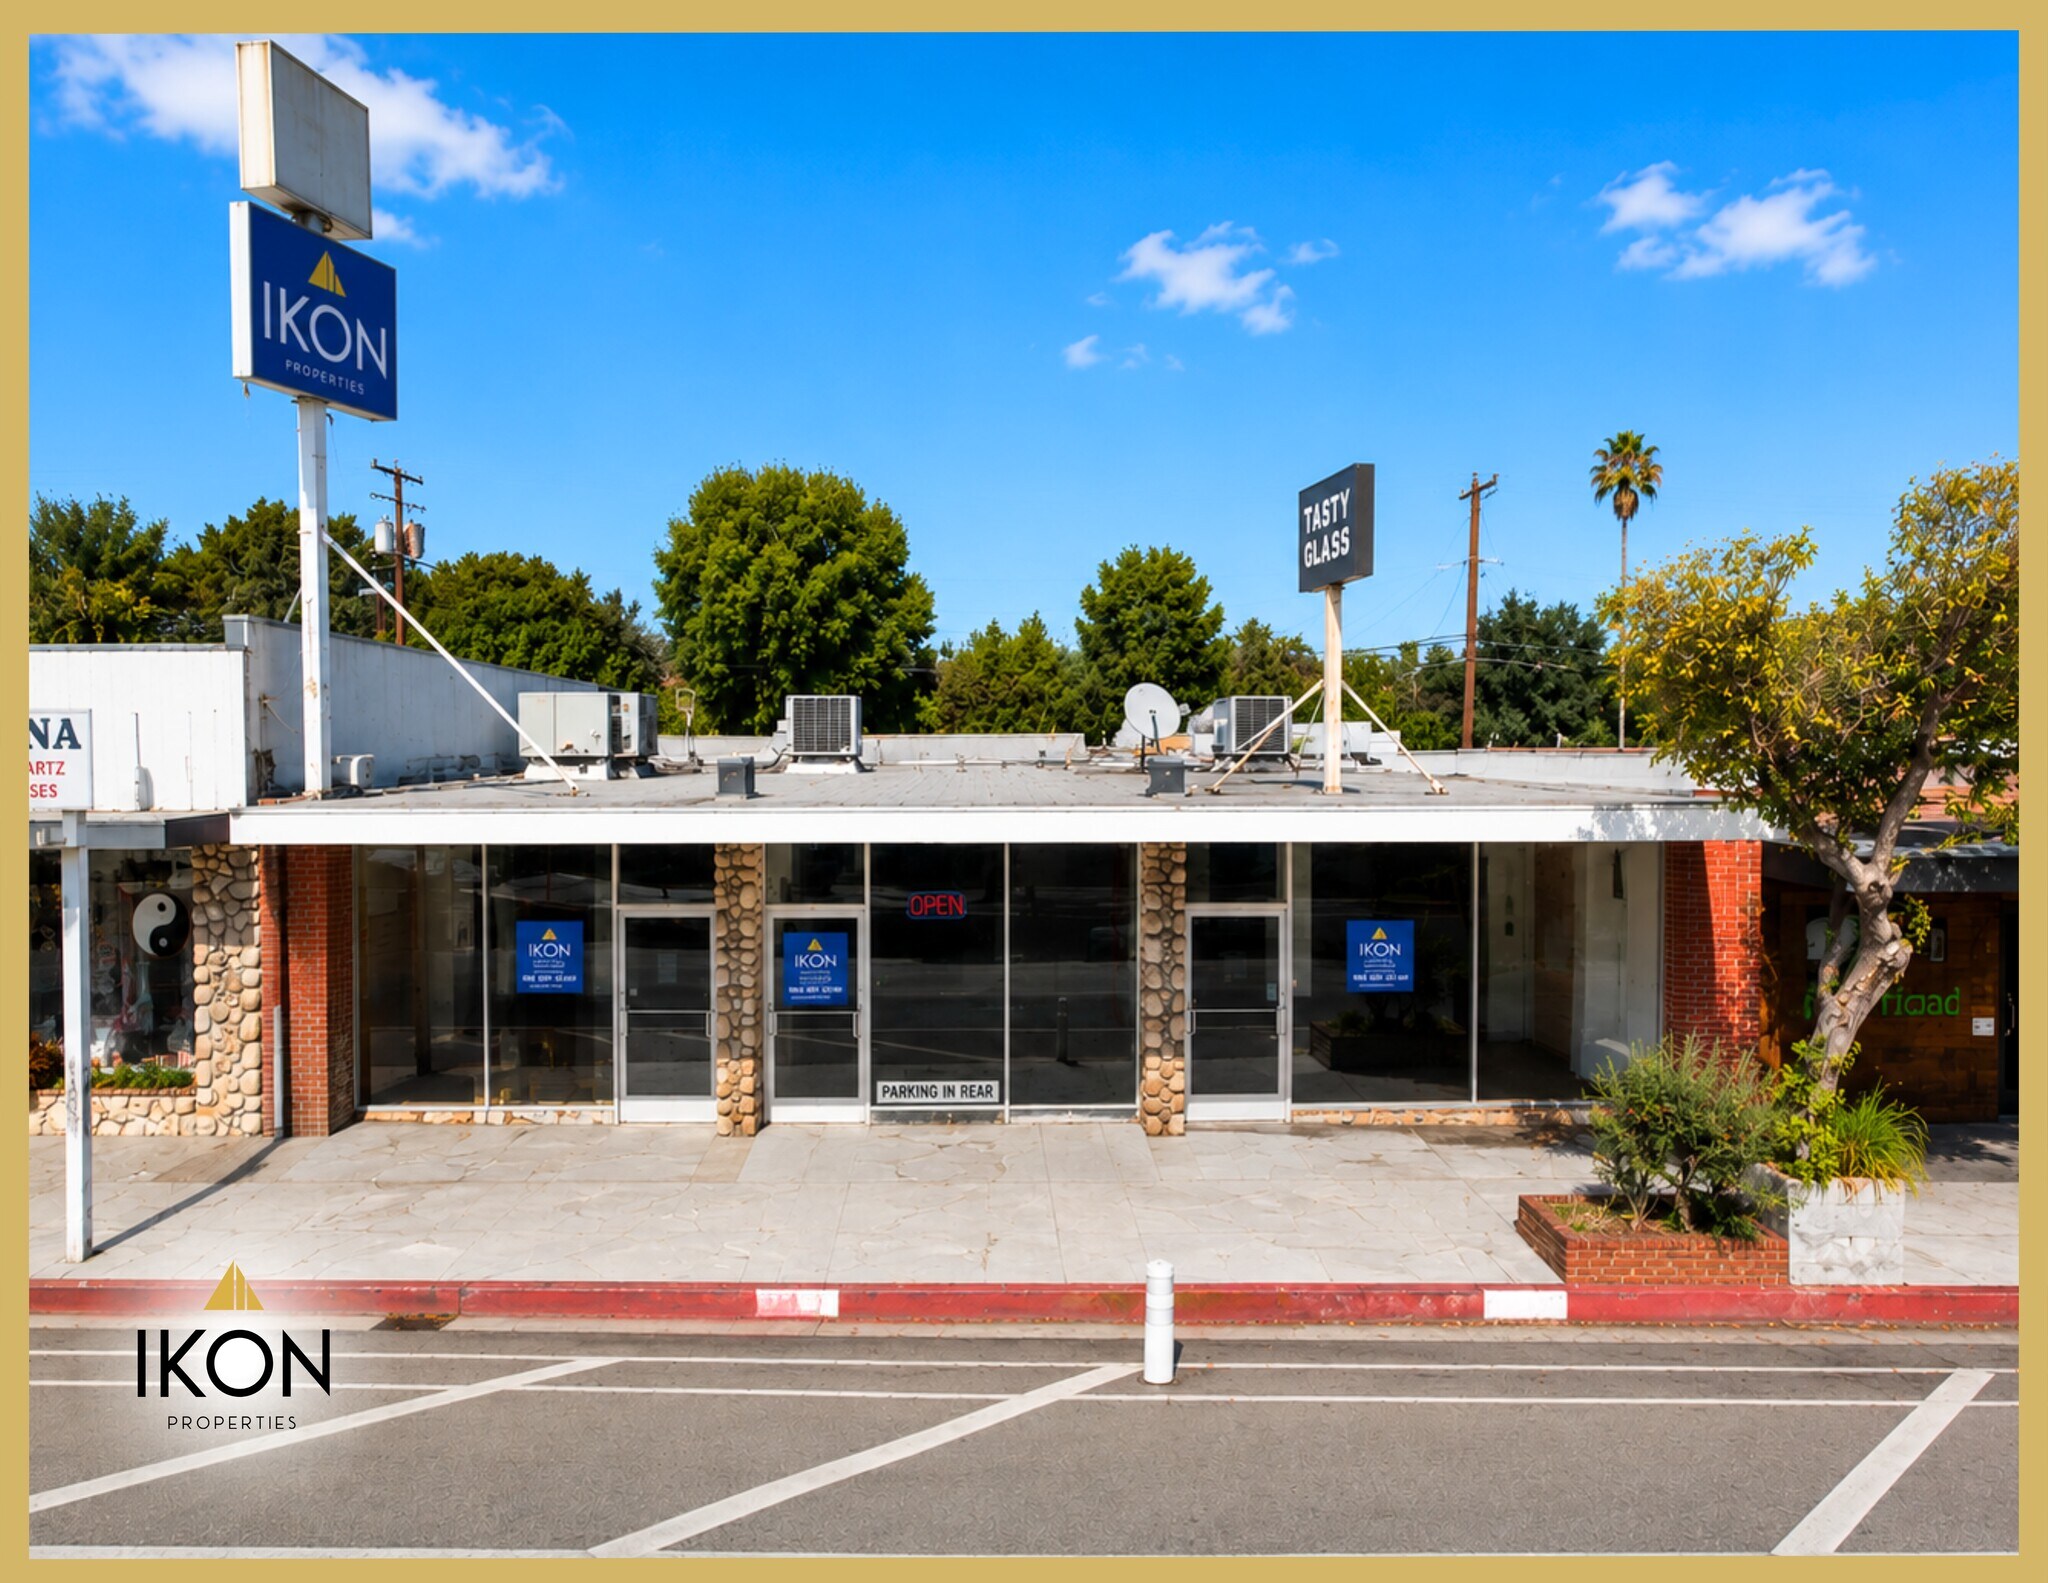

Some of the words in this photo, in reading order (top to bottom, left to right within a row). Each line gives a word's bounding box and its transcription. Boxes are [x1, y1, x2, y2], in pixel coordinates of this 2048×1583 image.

[263, 280, 387, 380] IKON
[285, 358, 365, 396] PROPERTIES
[1303, 487, 1350, 534] TASTY
[1303, 525, 1350, 568] GLASS
[910, 894, 964, 916] OPEN
[528, 942, 571, 958] IKON
[794, 953, 837, 968] IKON
[1359, 942, 1401, 957] IKON
[882, 1084, 938, 1099] PARKING
[943, 1084, 956, 1099] IN
[960, 1084, 994, 1099] REAR
